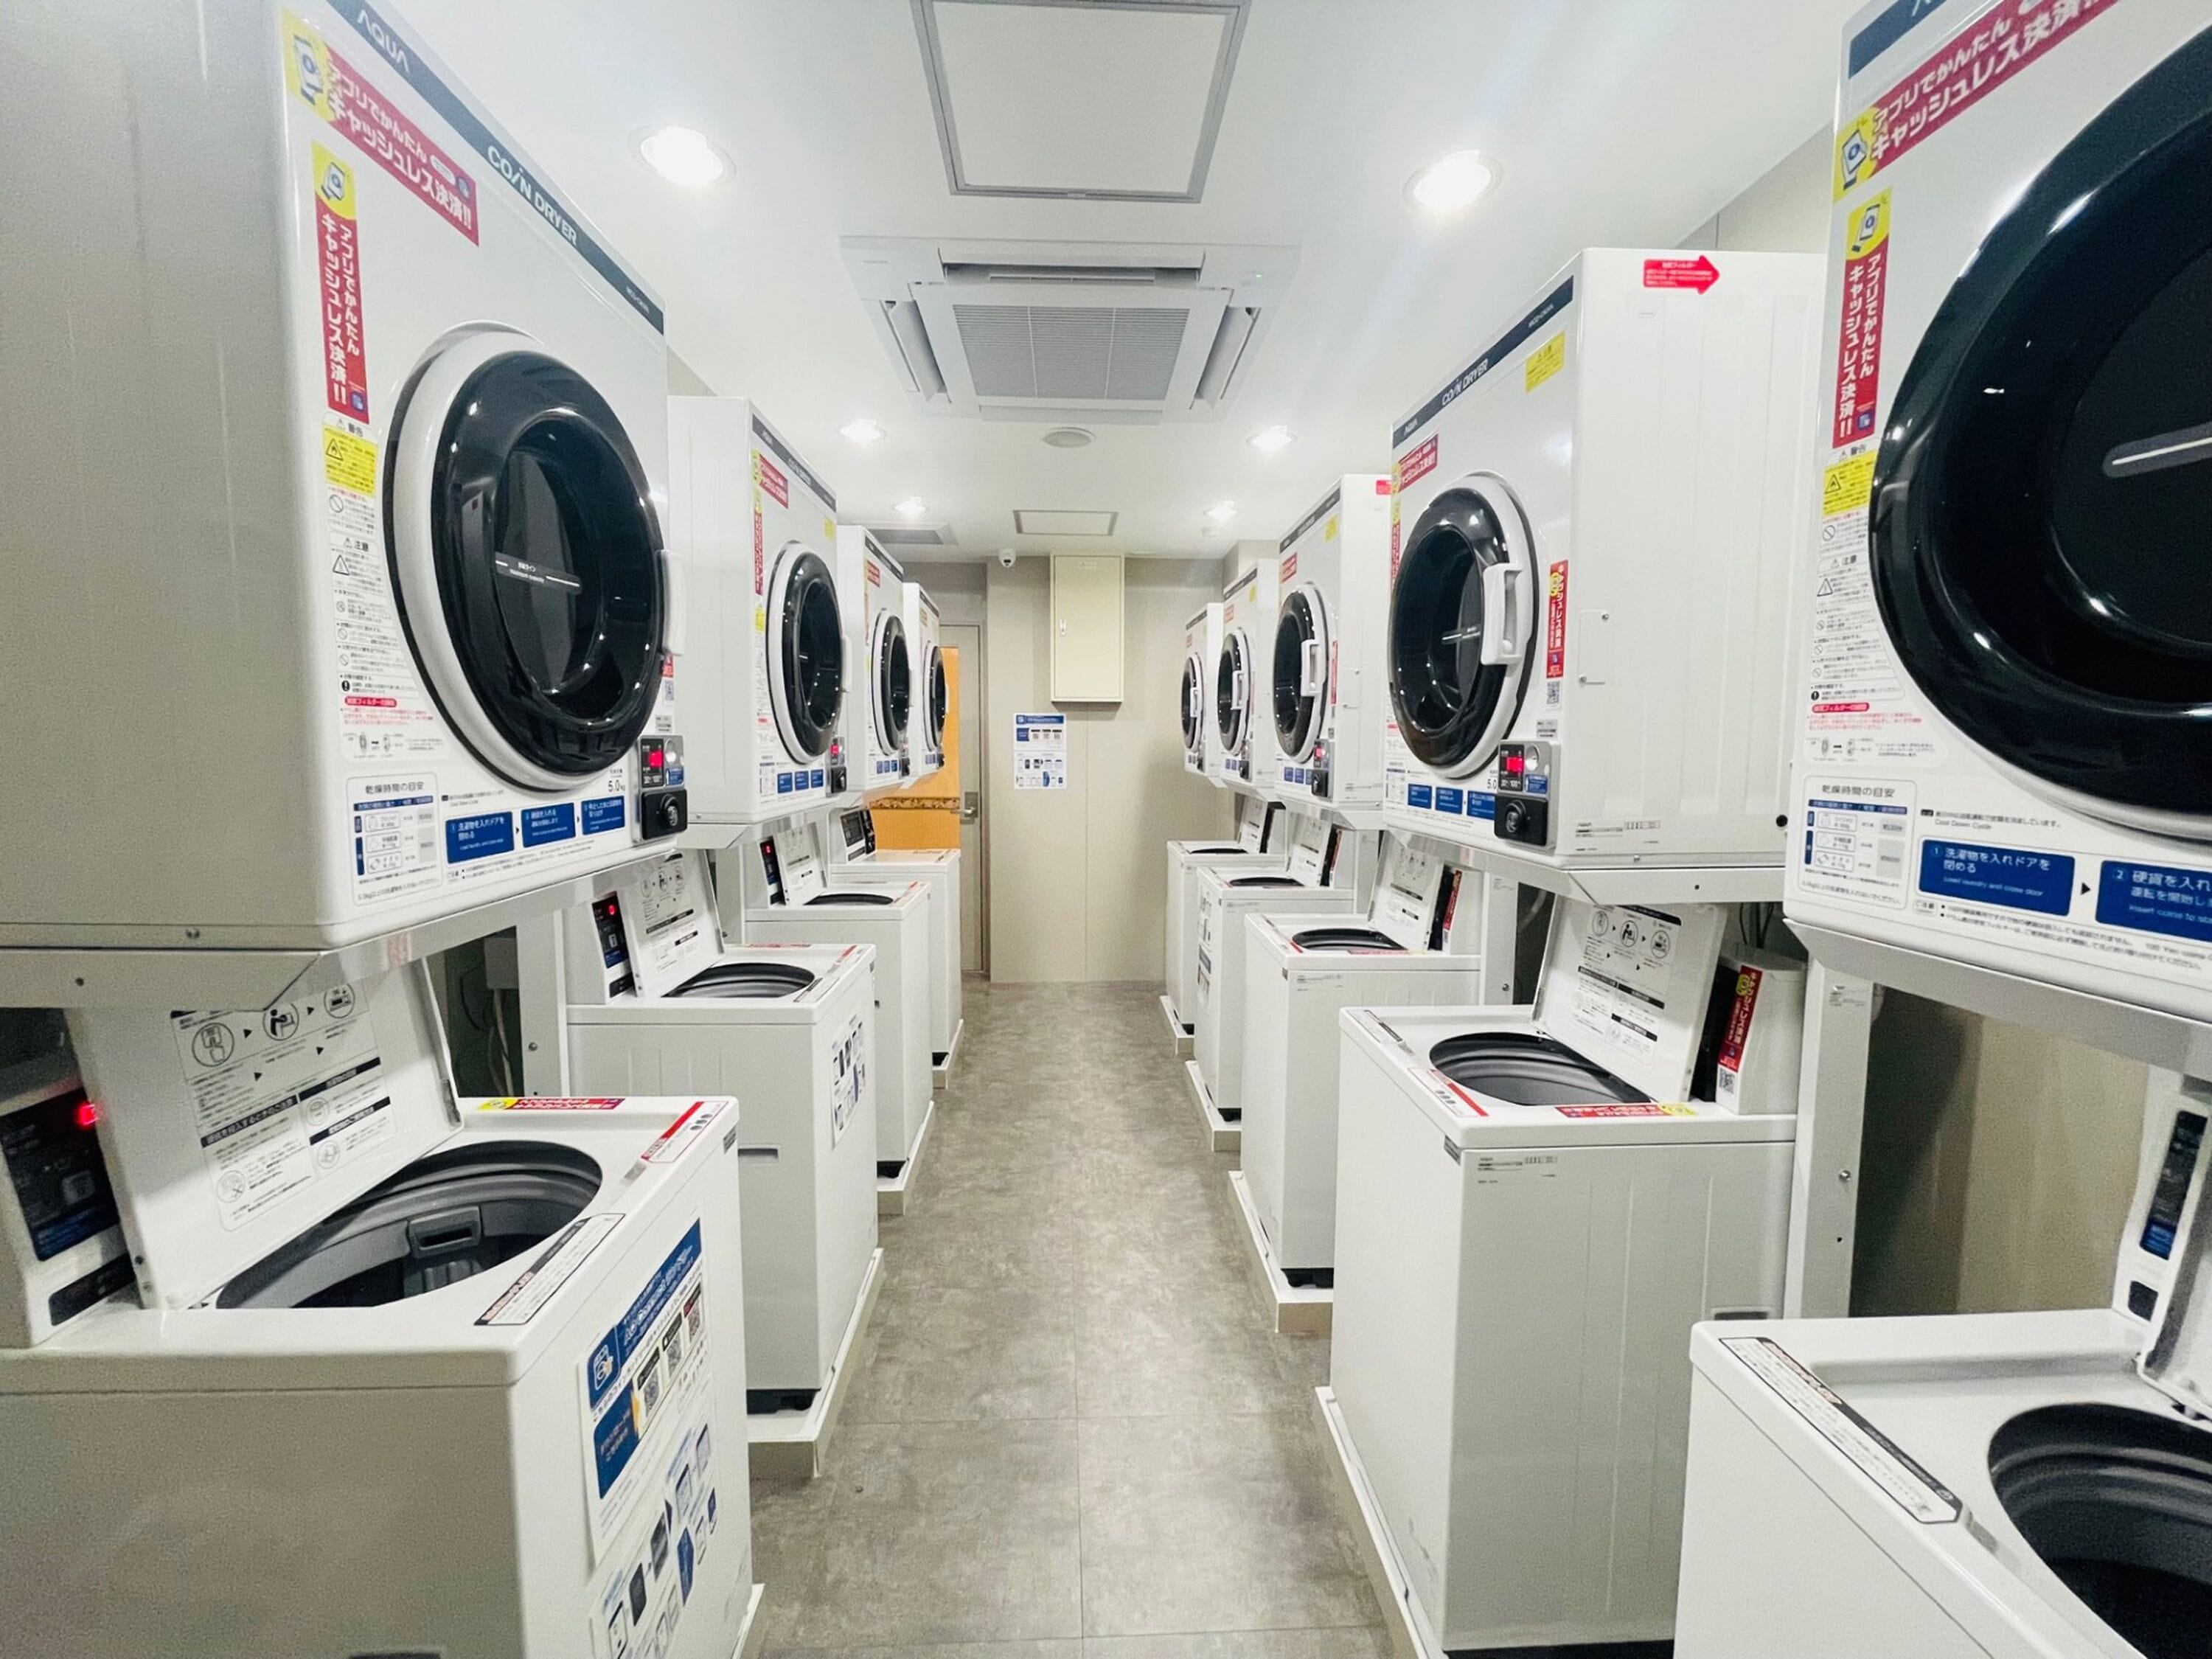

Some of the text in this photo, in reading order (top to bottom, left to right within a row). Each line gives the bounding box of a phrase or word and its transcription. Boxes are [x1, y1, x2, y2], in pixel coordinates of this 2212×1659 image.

[357, 10, 410, 72] AQUA
[1871, 17, 2011, 132] アプリでかんたん
[1871, 0, 2096, 160] キャッシュレス決済
[327, 54, 428, 165] アプリでかんたん
[534, 191, 577, 246] DRYER
[1860, 253, 1881, 379] アプリでかんたん
[1822, 784, 1896, 798] 乾燥時間の目安
[1943, 859, 1977, 874] 閉める
[1944, 846, 2051, 872] 洗濯物を入れドアを
